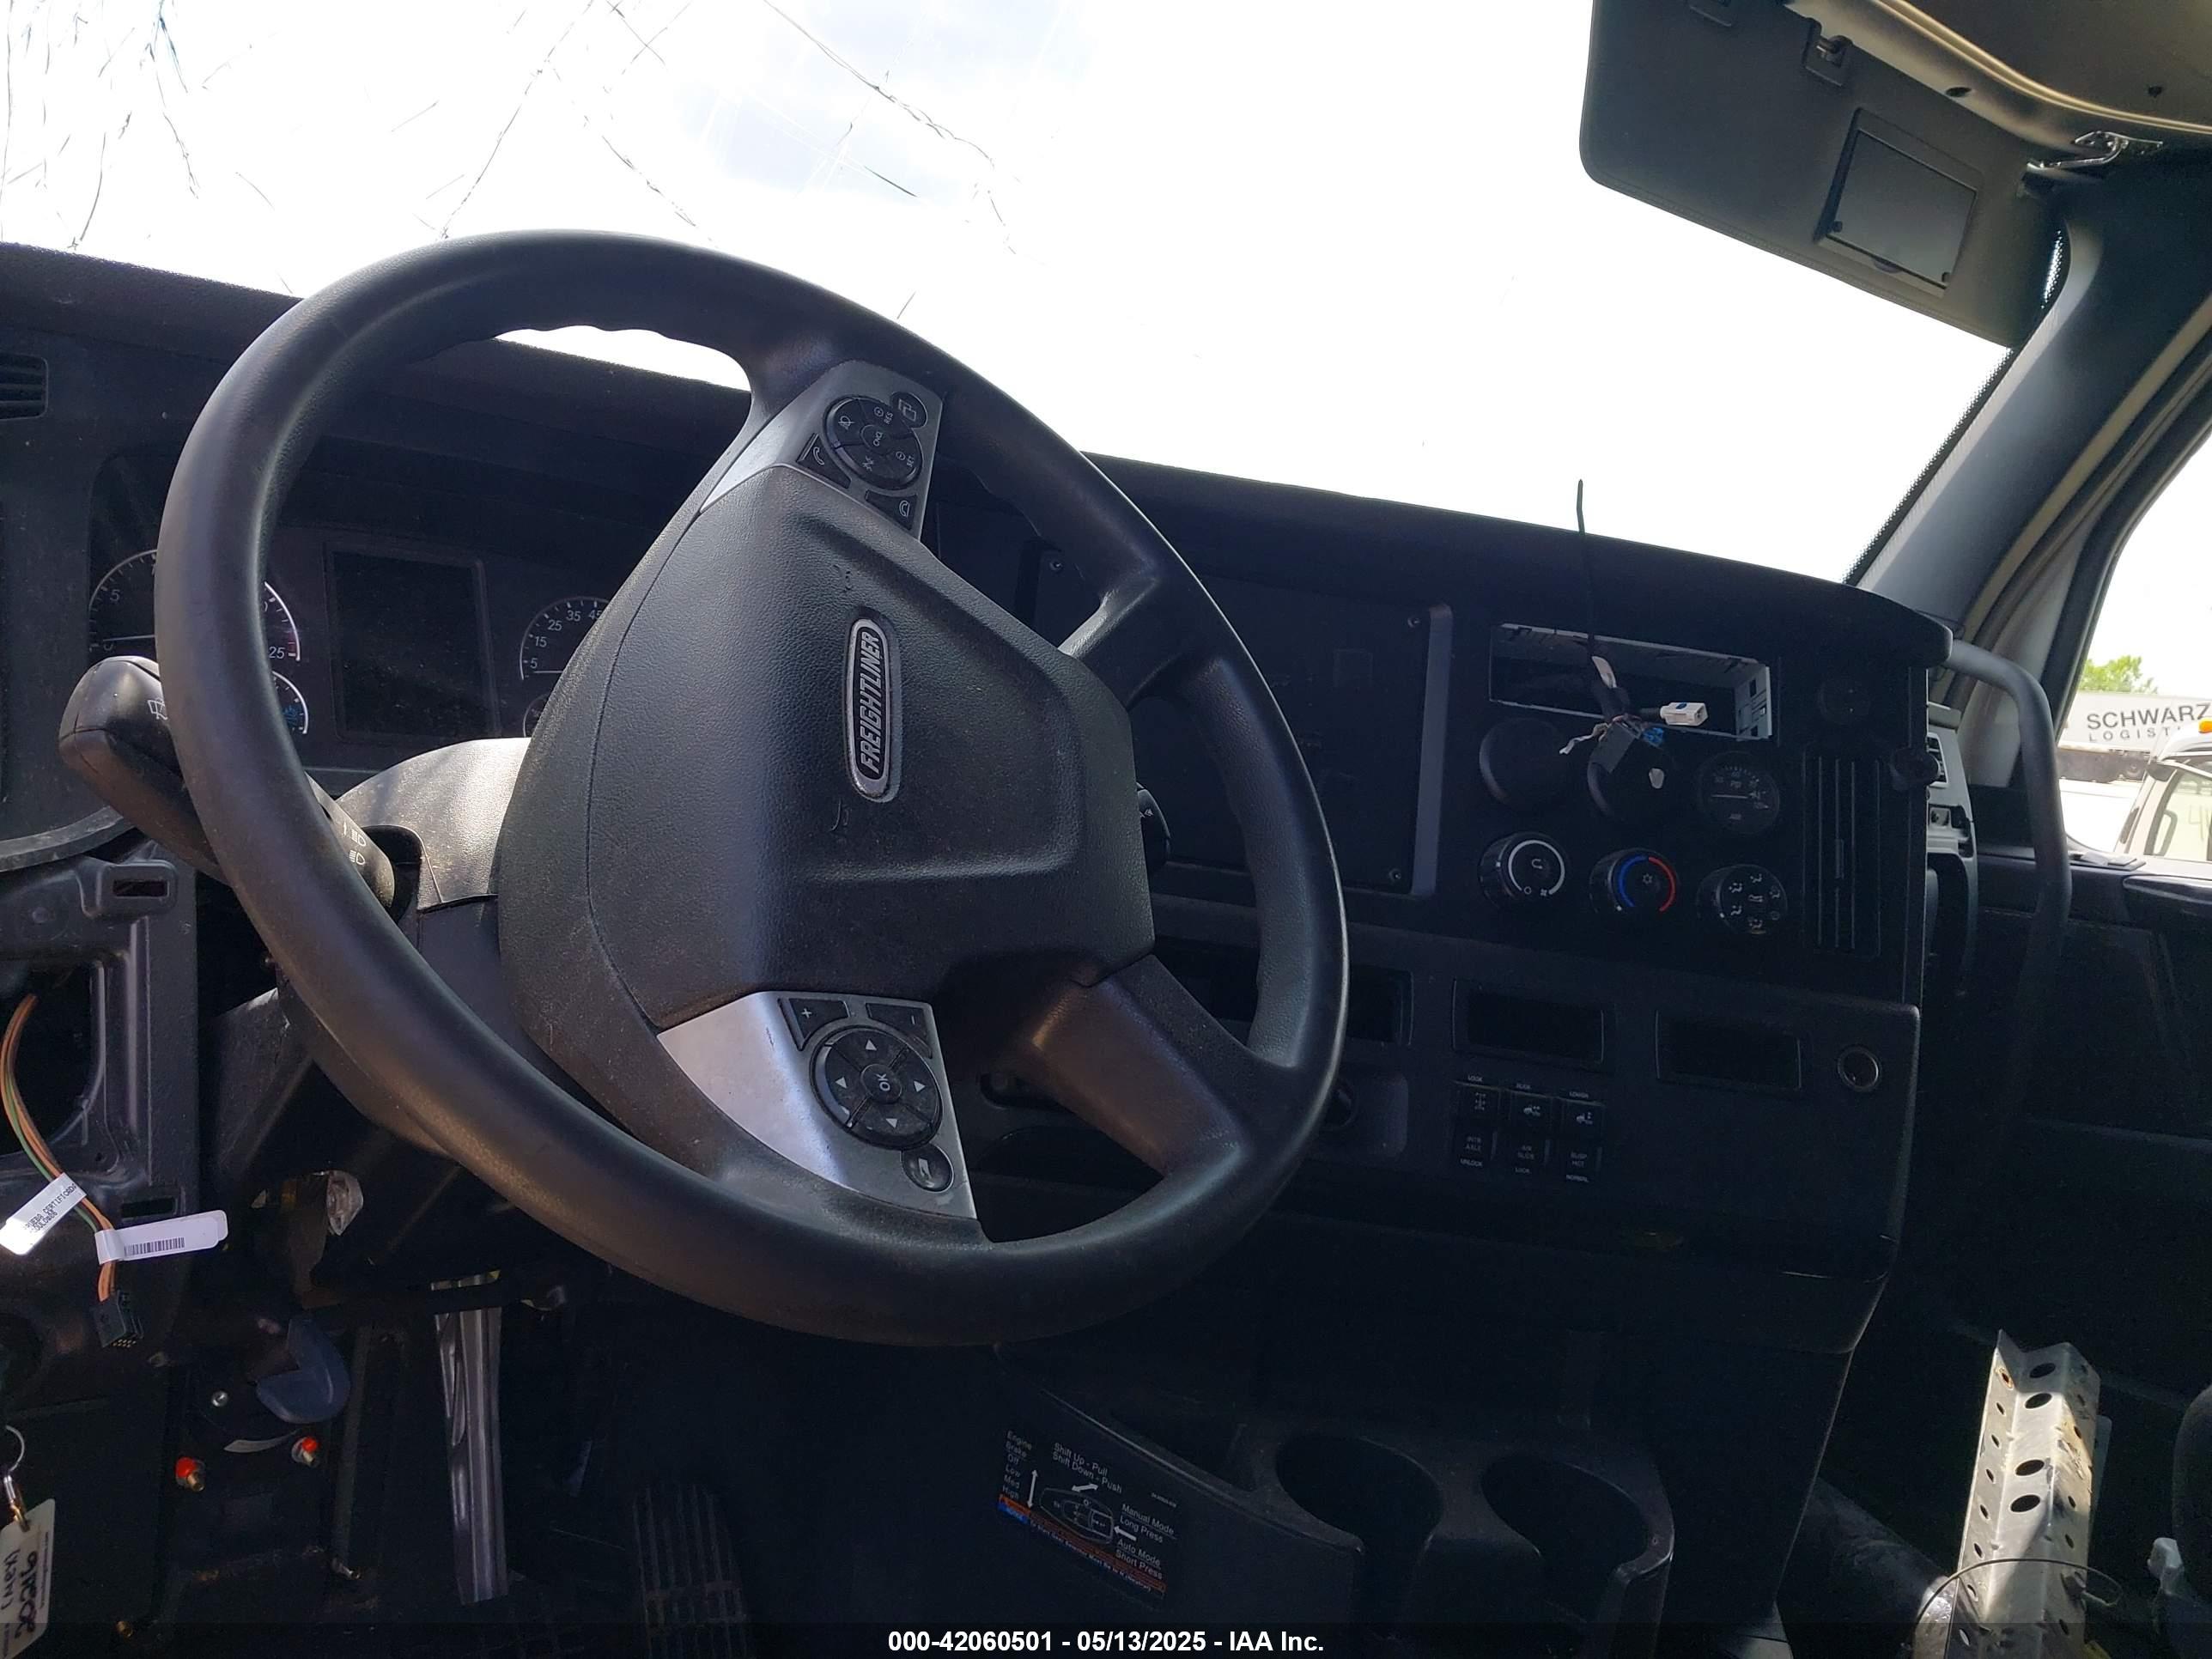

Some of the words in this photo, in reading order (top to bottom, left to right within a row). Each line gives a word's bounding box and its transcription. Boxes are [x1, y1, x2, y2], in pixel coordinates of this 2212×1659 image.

[109, 589, 121, 602] 5
[566, 610, 581, 622] 35
[547, 619, 562, 631] 25
[534, 635, 547, 647] 15
[268, 646, 285, 659] 25
[530, 658, 538, 669] 5
[860, 631, 883, 775] FREIGHTLINER
[2087, 702, 2212, 730] SCHWARZ
[2088, 726, 2181, 742] LOGIST
[875, 1073, 890, 1091] OK
[1092, 1462, 1108, 1476] Pull
[1072, 1462, 1094, 1480] Down
[1102, 1475, 1122, 1494] Push
[1121, 1504, 1150, 1526] Manual
[1152, 1517, 1175, 1535] Mode
[1120, 1516, 1139, 1533] Long
[1140, 1528, 1164, 1544] Press
[1117, 1539, 1137, 1554] Auto
[1138, 1549, 1160, 1566] Mode
[1115, 1549, 1138, 1566] Short
[1139, 1562, 1163, 1579] Press
